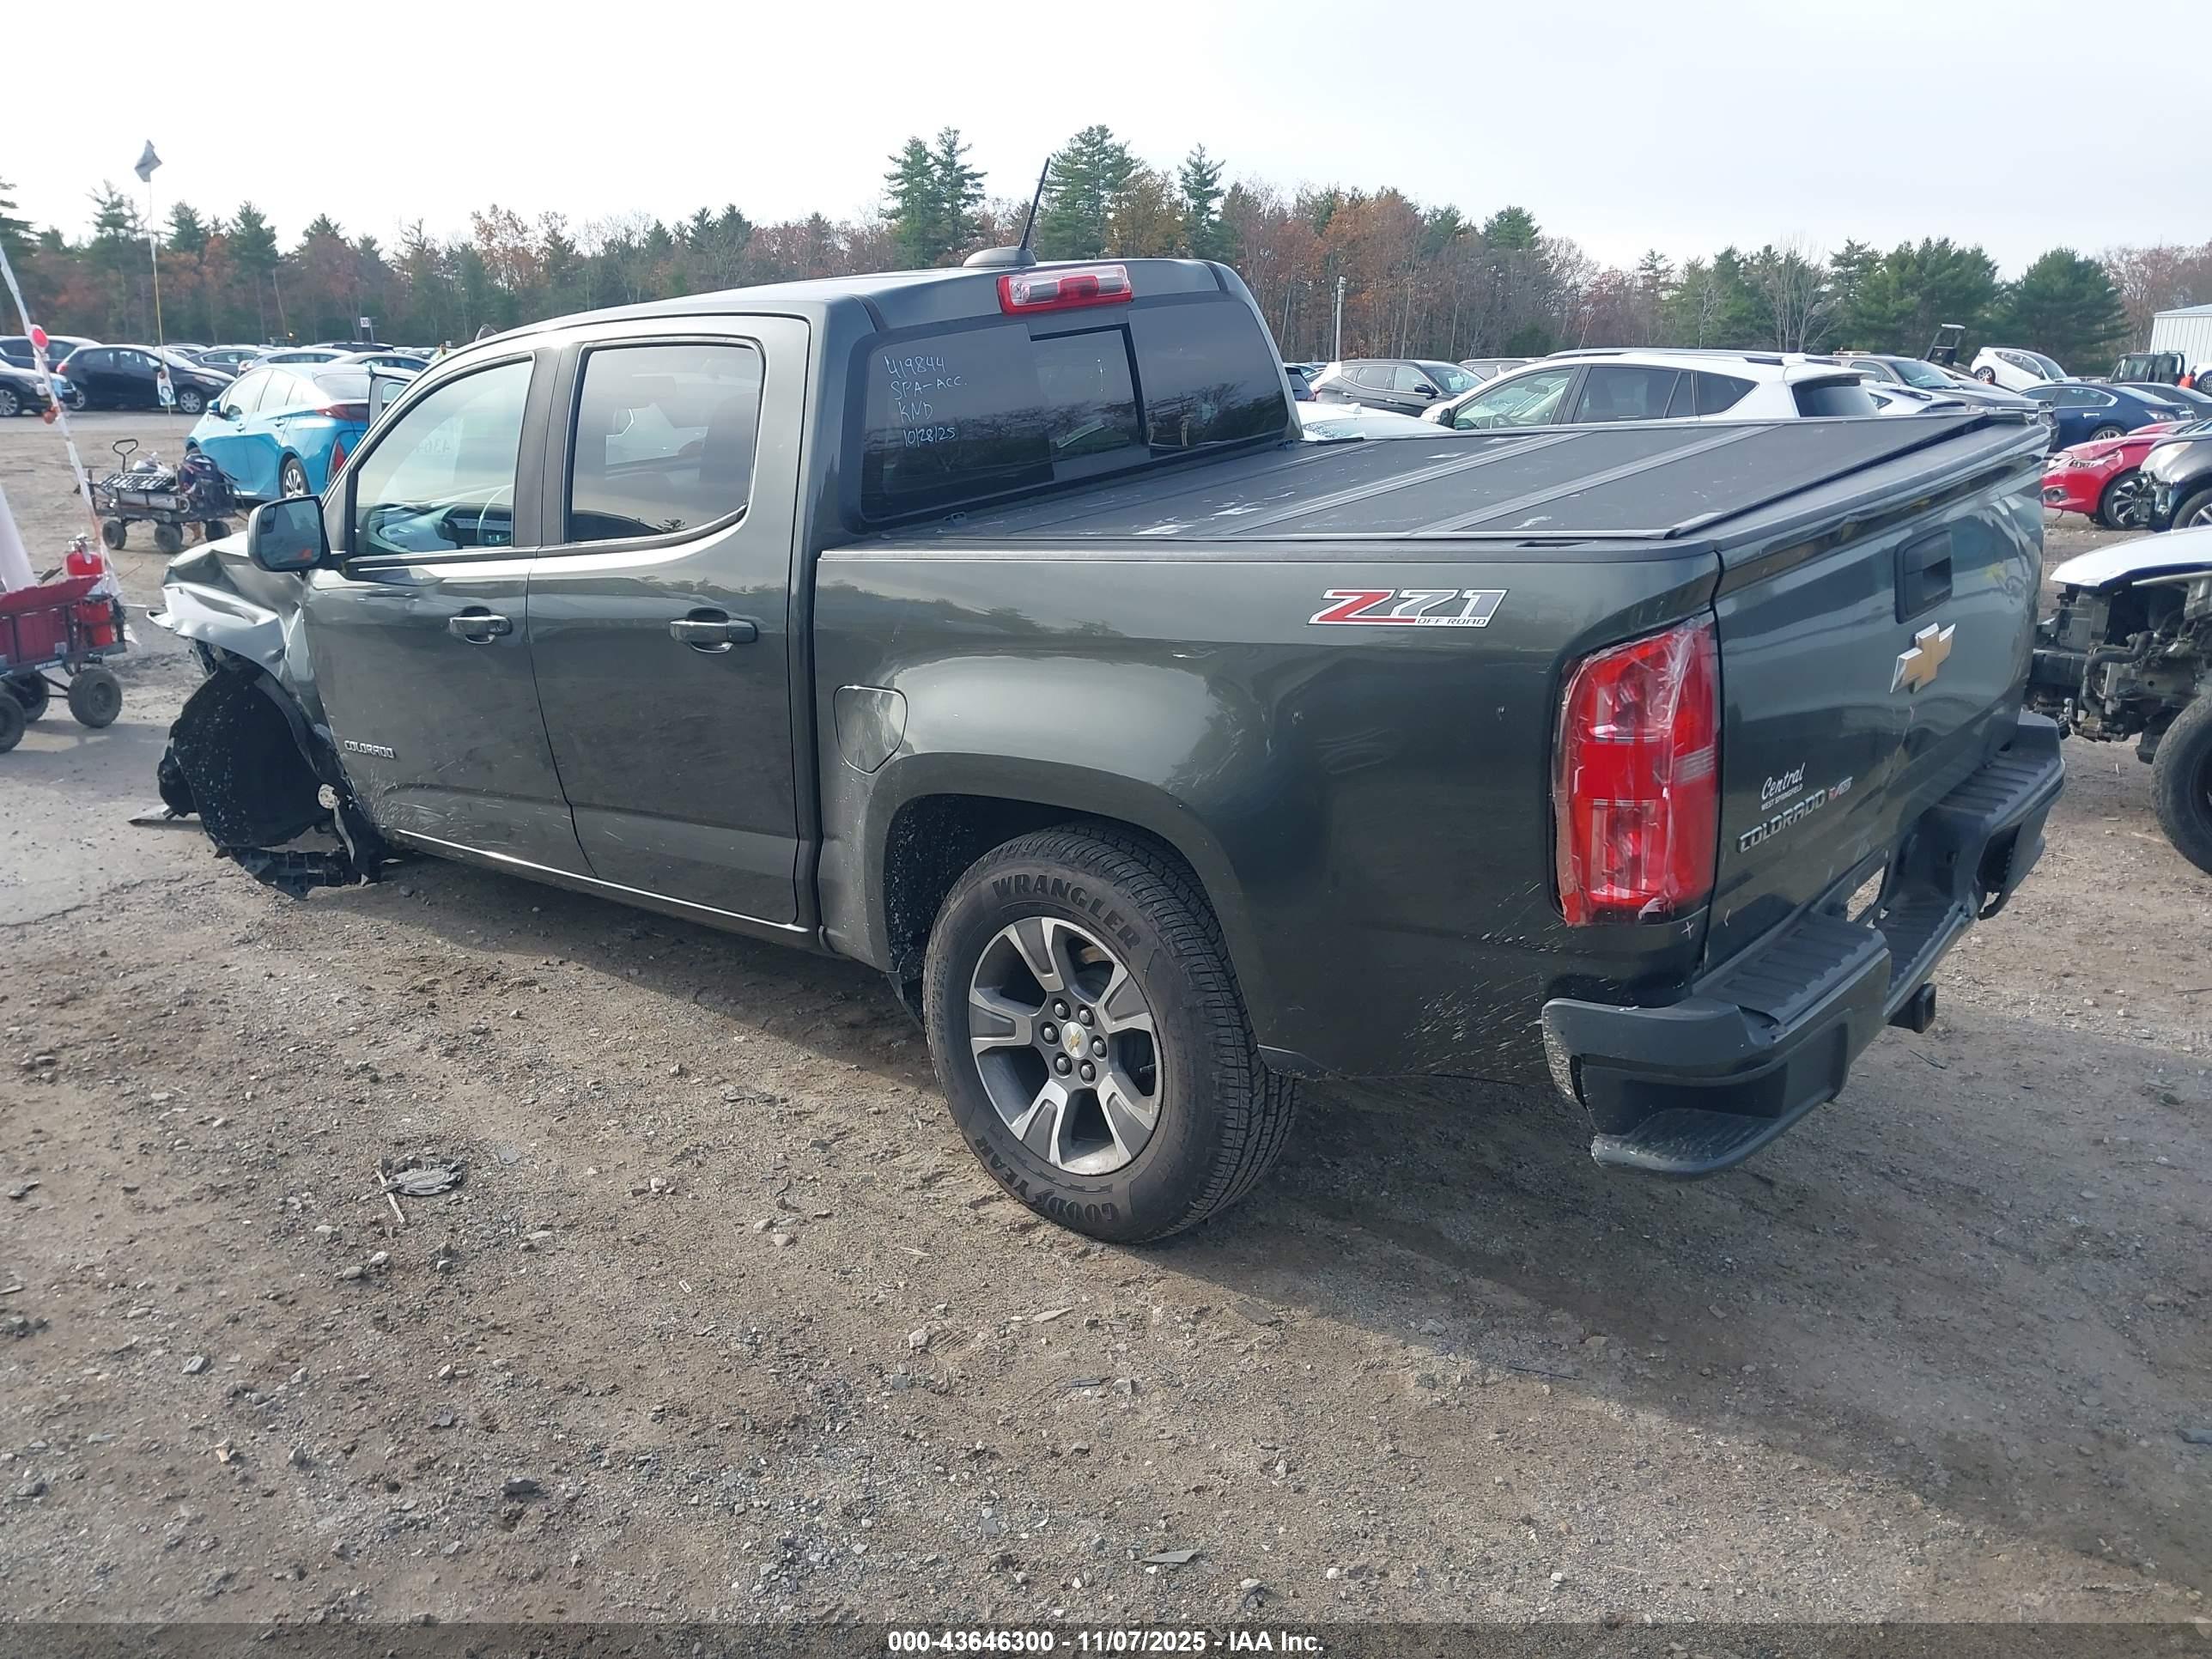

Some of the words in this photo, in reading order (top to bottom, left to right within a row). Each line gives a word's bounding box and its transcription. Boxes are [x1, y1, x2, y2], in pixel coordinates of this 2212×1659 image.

[884, 356, 945, 379] 419844
[902, 427, 956, 447] 10/28/25
[1308, 588, 1510, 628] Z71
[343, 739, 395, 759] COLORADO
[1761, 763, 1805, 800] Central
[1761, 799, 1774, 811] WEST
[1775, 783, 1803, 804] SPRINGFIELD
[1738, 789, 1826, 853] COLORADO
[992, 873, 1142, 950] WRANGLER
[974, 1135, 1120, 1224] GOODYEAR
